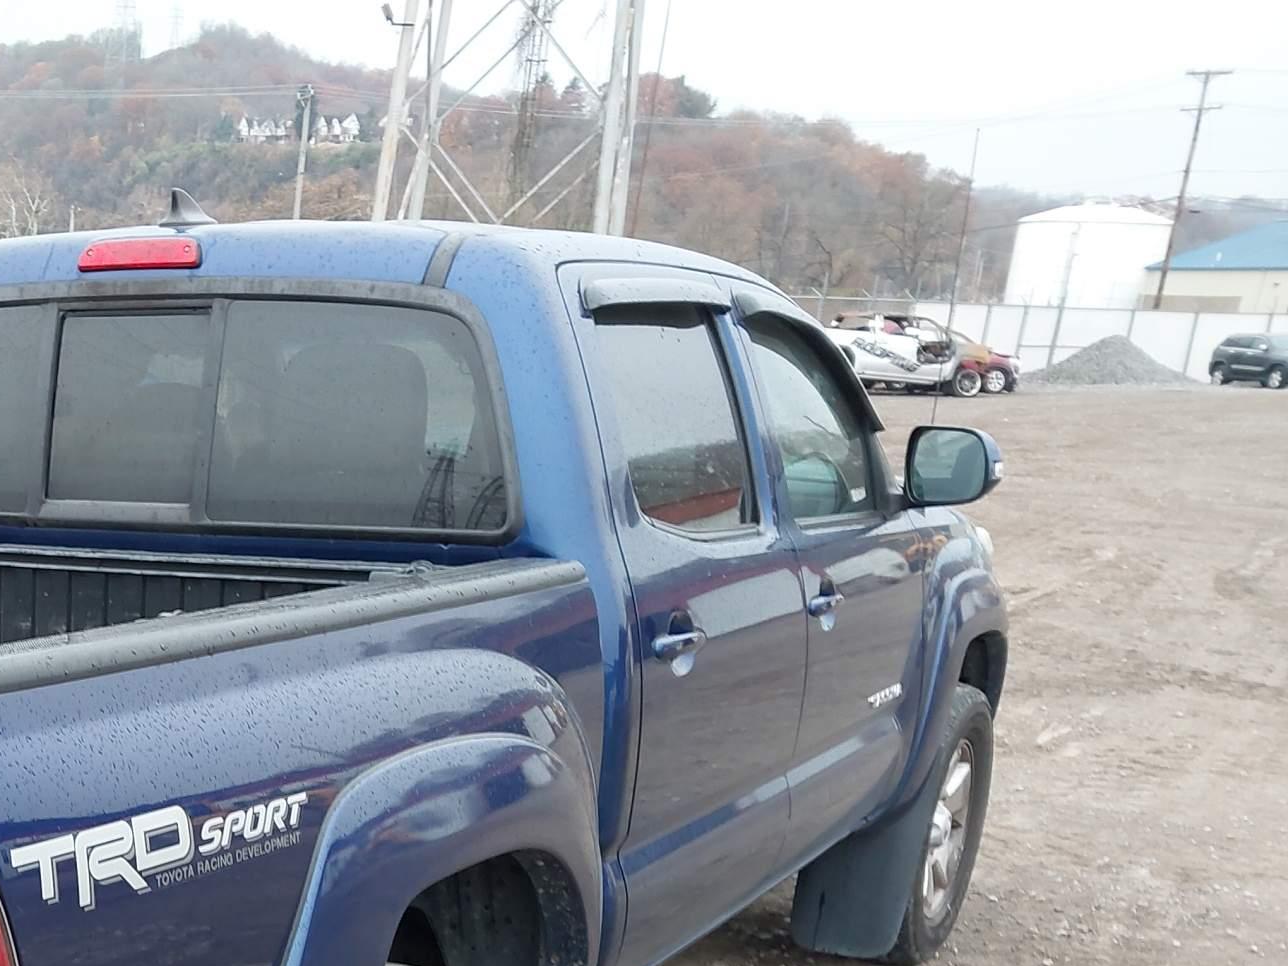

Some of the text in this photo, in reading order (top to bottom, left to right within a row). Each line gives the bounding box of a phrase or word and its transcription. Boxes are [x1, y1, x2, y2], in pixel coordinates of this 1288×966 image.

[11, 792, 307, 911] TRD SPORT
[156, 832, 300, 887] TOYOTA RACING DEVELOPMENT
